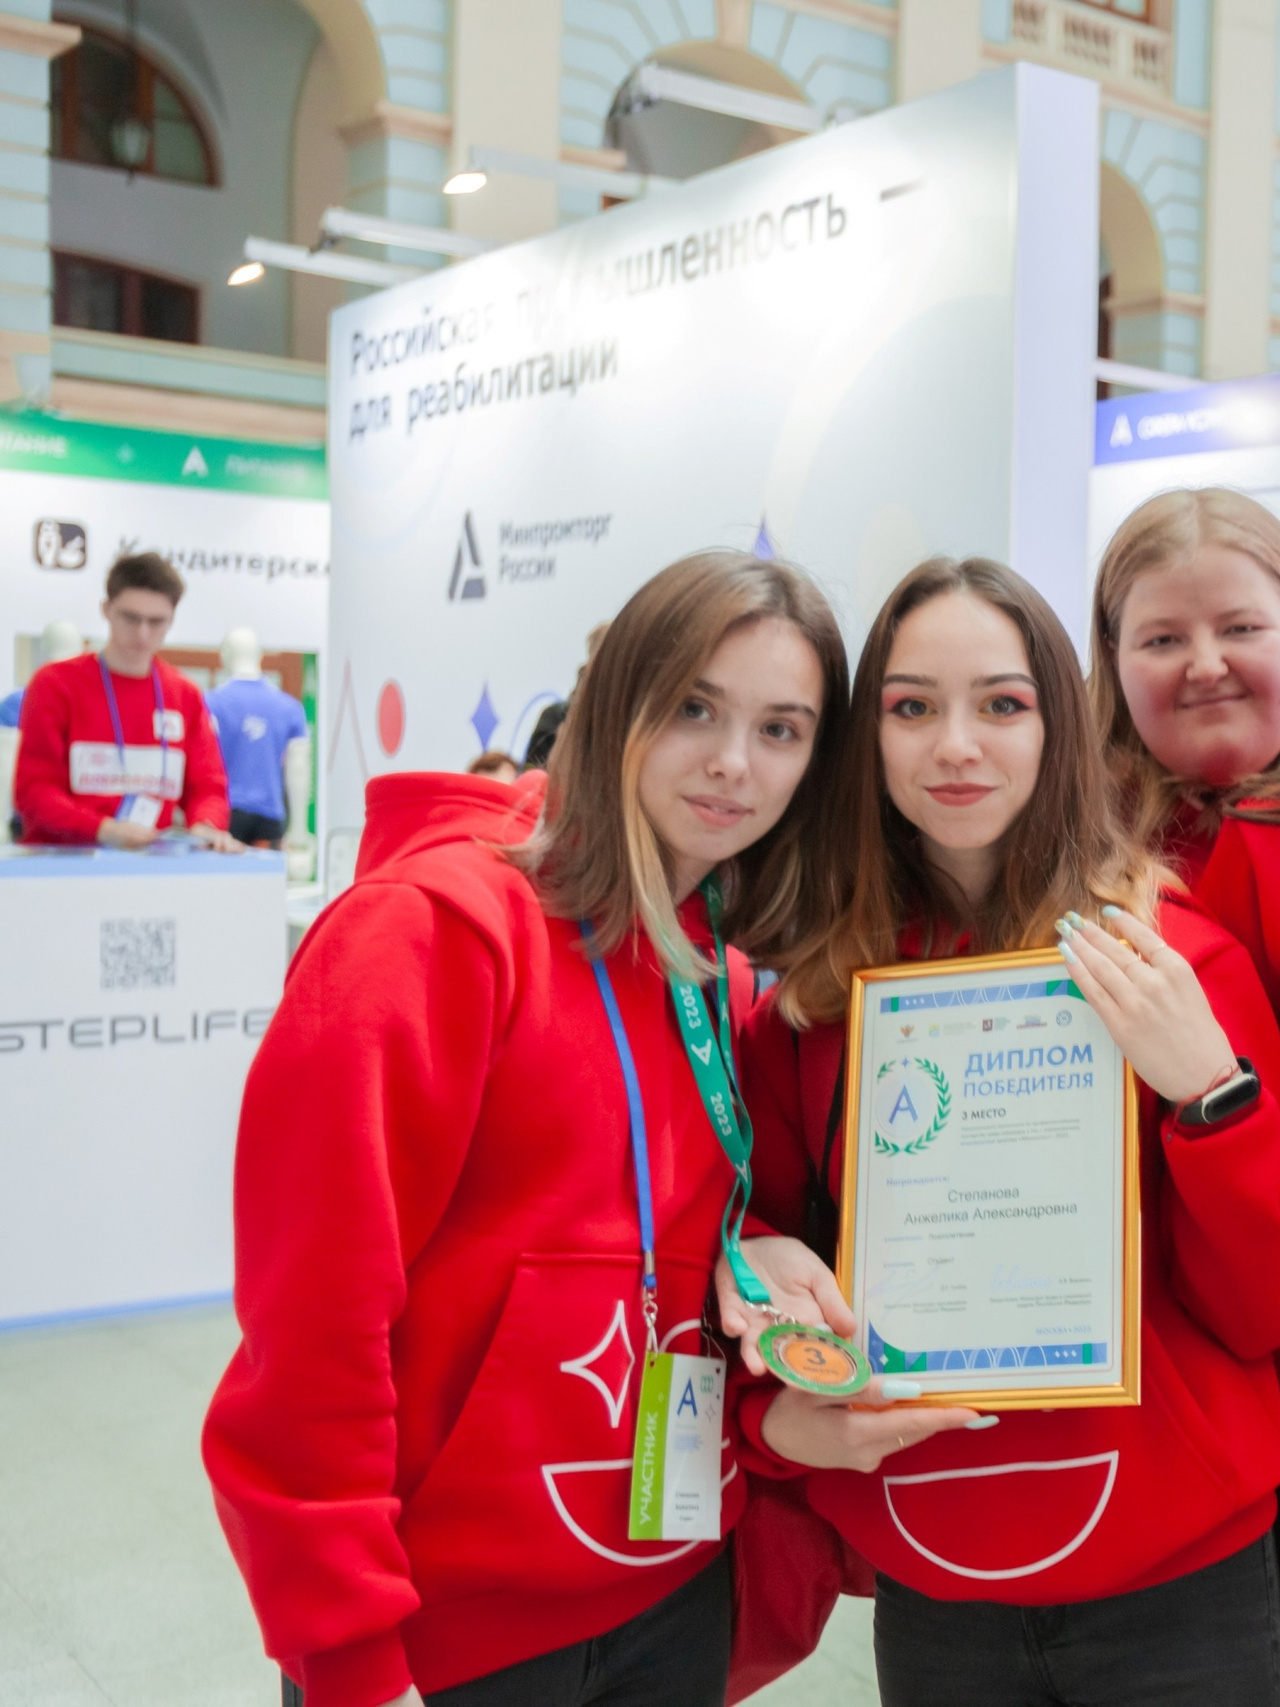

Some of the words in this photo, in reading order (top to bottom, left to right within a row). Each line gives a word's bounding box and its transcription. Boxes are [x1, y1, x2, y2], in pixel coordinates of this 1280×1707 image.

[517, 193, 848, 342] пршленность
[350, 394, 392, 443] для
[408, 340, 619, 433] реабилитации
[117, 533, 331, 583] Кндитерск
[500, 554, 556, 584] России
[679, 985, 702, 1030] 2023
[964, 1043, 1094, 1077] ДИПЛОМ
[963, 1072, 1094, 1098] ПОБЕДИТЕЛЯ
[710, 1091, 732, 1137] 2023
[961, 1111, 968, 1121] 3
[970, 1107, 1007, 1120] МЕСТО
[947, 1186, 1020, 1204] Степанова
[904, 1209, 969, 1226] Анжелика
[973, 1201, 1078, 1222] Александровна
[803, 1346, 827, 1366] 3
[640, 1410, 659, 1525] УЧАСТНИК
